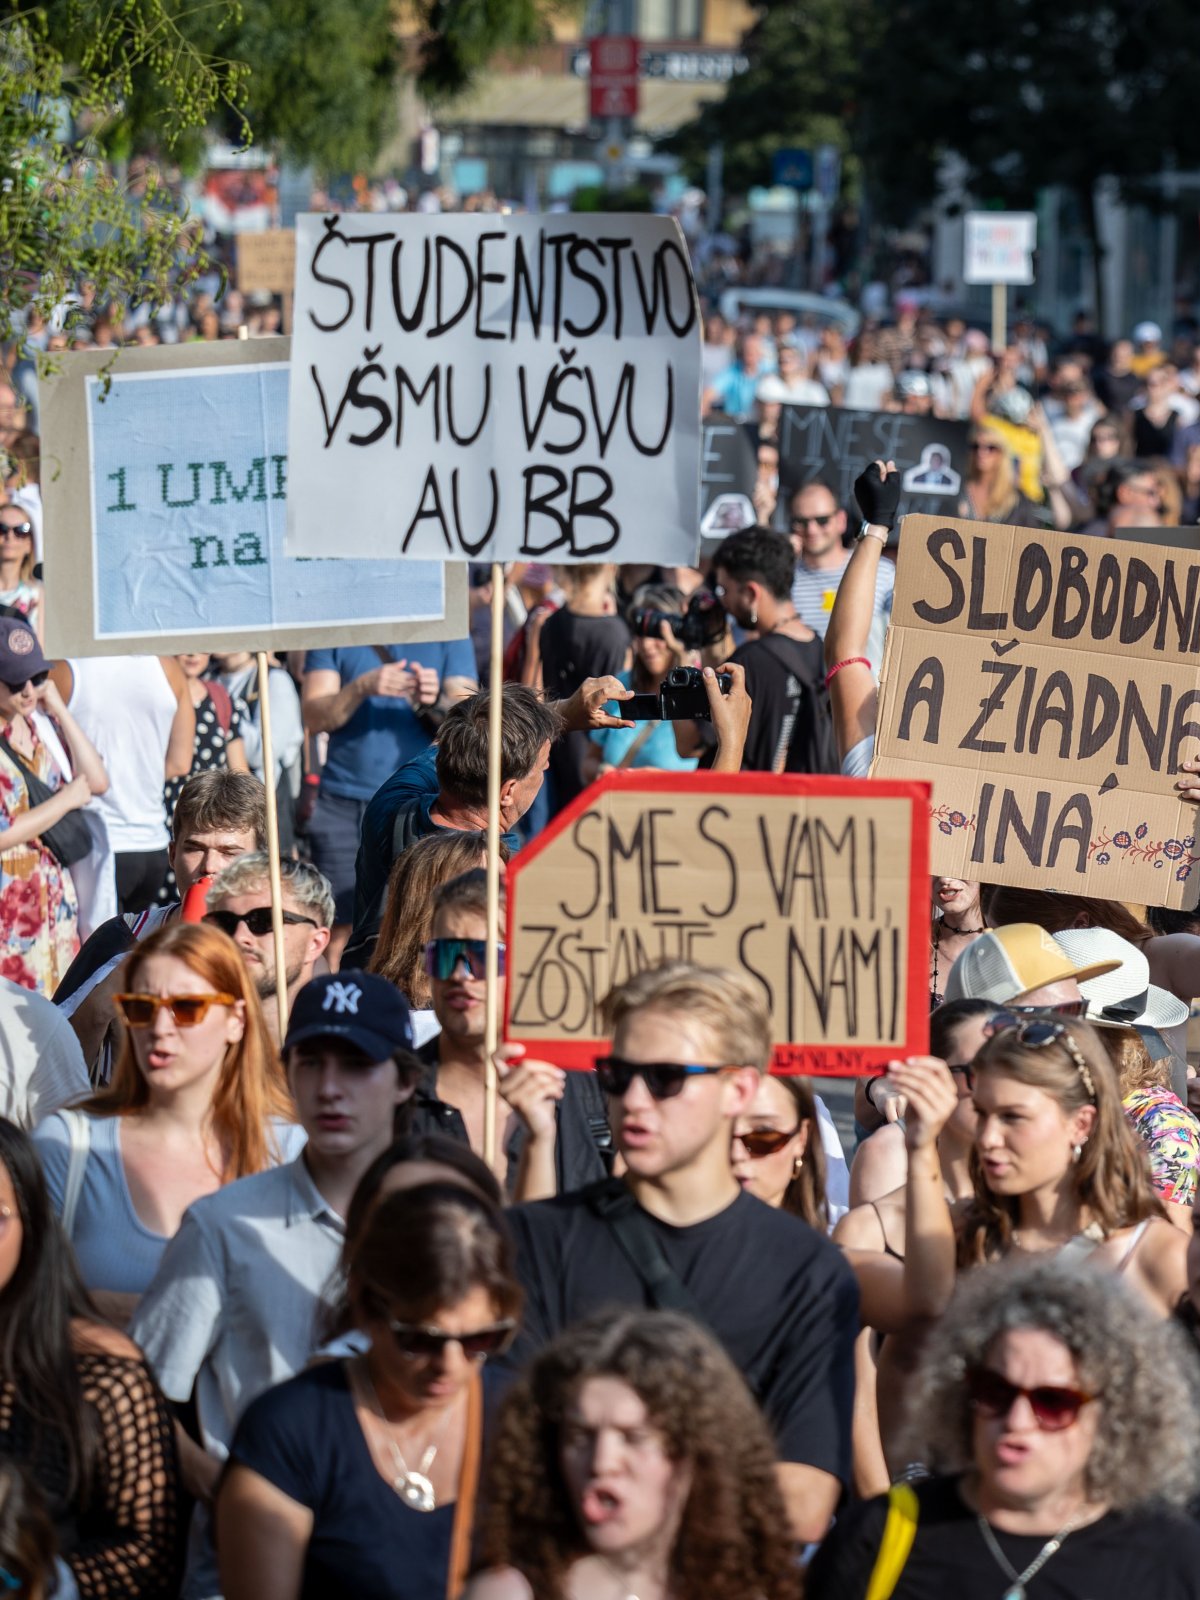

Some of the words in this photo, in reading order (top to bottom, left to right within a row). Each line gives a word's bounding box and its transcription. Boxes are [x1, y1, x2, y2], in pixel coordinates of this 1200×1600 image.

[309, 214, 697, 342] ŠTUDENTSTVO
[311, 343, 493, 449] VŠMU
[518, 346, 674, 458] VŠVU
[107, 467, 137, 511] 1
[401, 464, 501, 557] AU
[520, 464, 622, 558] BB
[189, 532, 267, 569] na
[896, 656, 945, 745] A
[560, 809, 682, 920] SME
[697, 804, 739, 919] S
[970, 772, 1120, 874] INÁ
[322, 981, 362, 1014] NY
[737, 921, 774, 1016] S
[787, 924, 900, 1044] NAMI
